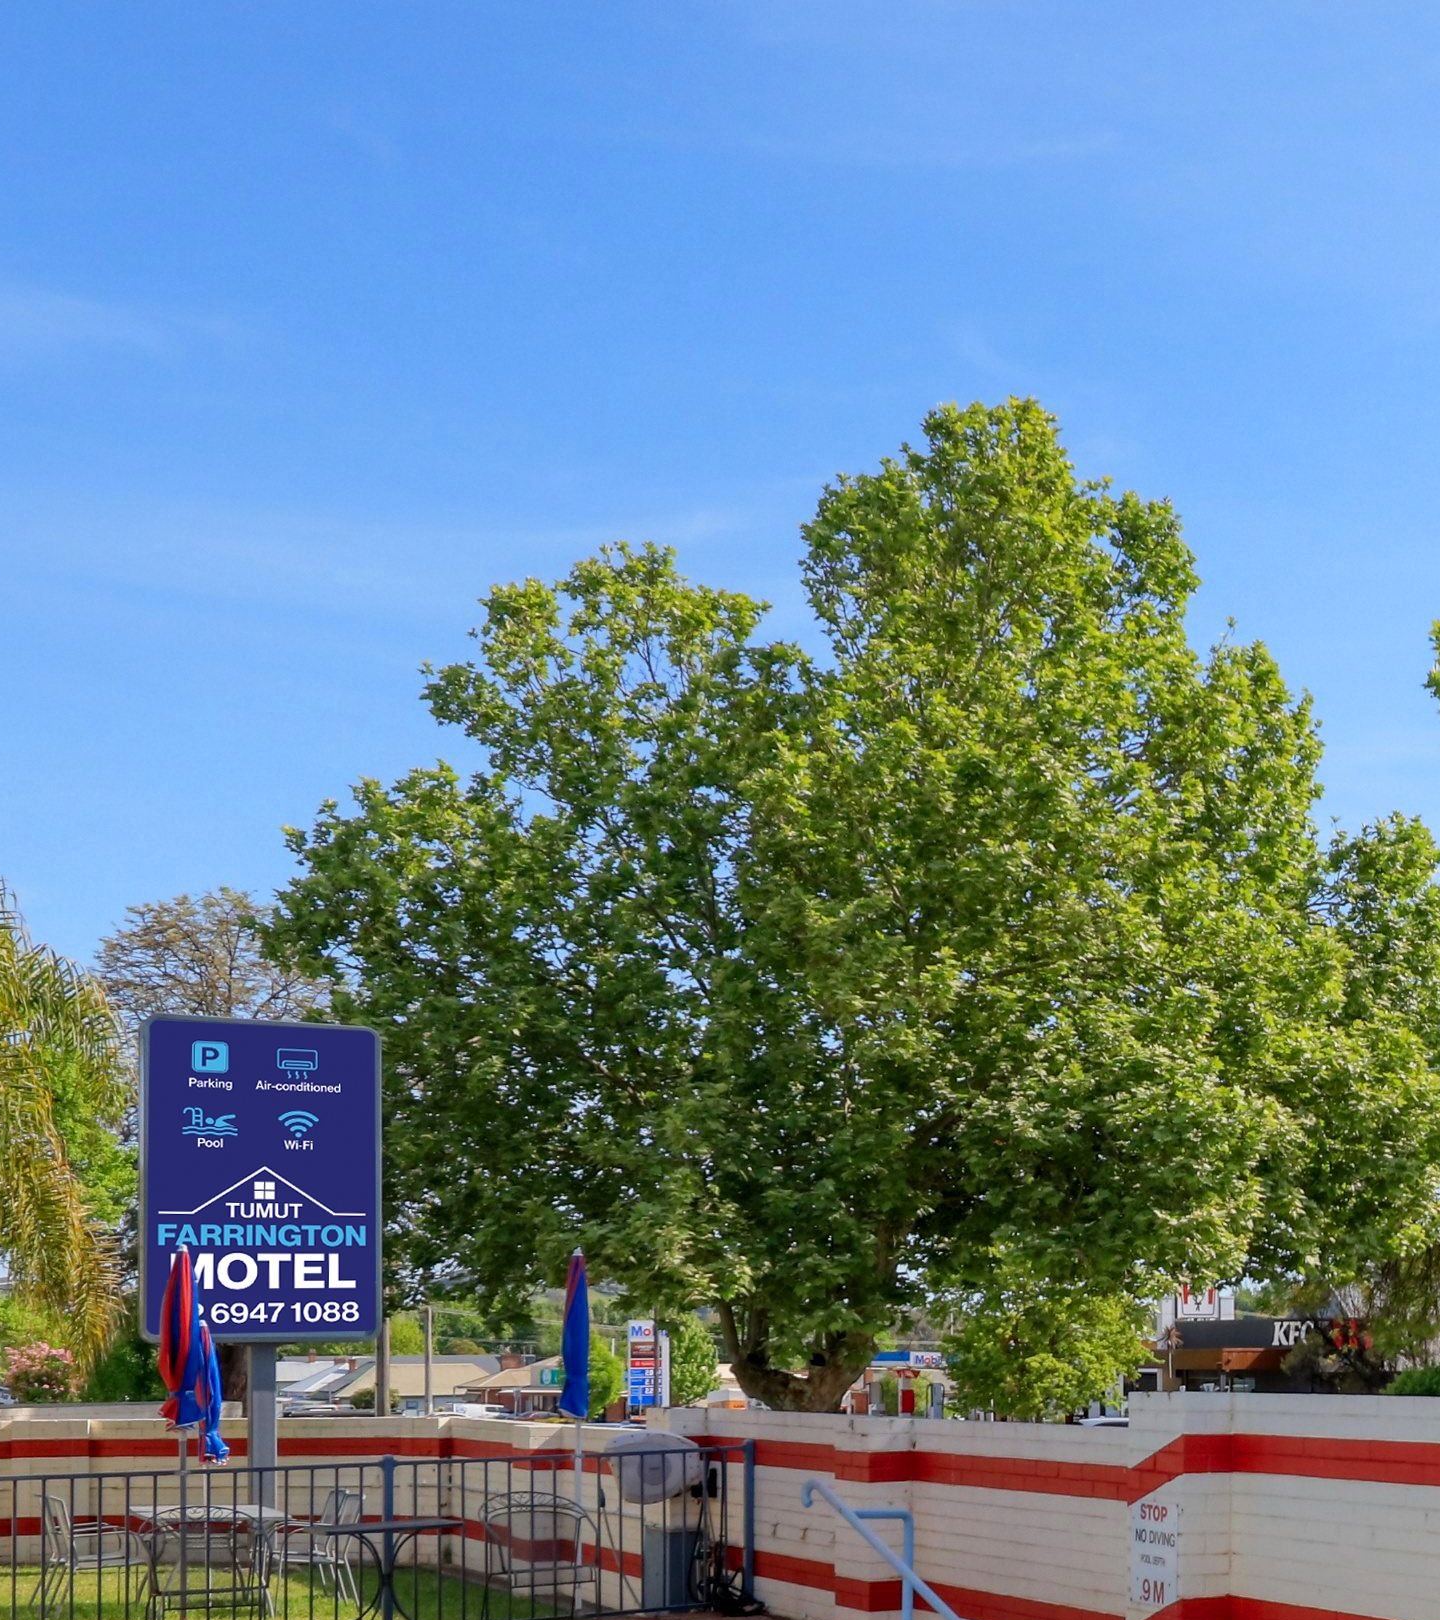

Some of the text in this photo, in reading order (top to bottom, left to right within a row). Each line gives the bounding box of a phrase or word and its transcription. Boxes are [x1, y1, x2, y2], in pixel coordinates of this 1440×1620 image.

[201, 1047, 220, 1067] P
[188, 1077, 233, 1091] Parking
[255, 1080, 342, 1094] Air-conditioned
[197, 1137, 224, 1149] Pool
[284, 1139, 314, 1151] Wi-Fi
[225, 1202, 303, 1219] TUMUT
[157, 1223, 367, 1247] FARRINGTON
[171, 1252, 357, 1290] MOTEL
[210, 1301, 285, 1324] 6947
[291, 1302, 360, 1323] 1088
[1272, 1320, 1314, 1347] KFC
[1140, 1503, 1168, 1522] STOP
[1135, 1528, 1175, 1548] NO DIVING
[1153, 1580, 1165, 1604] M
